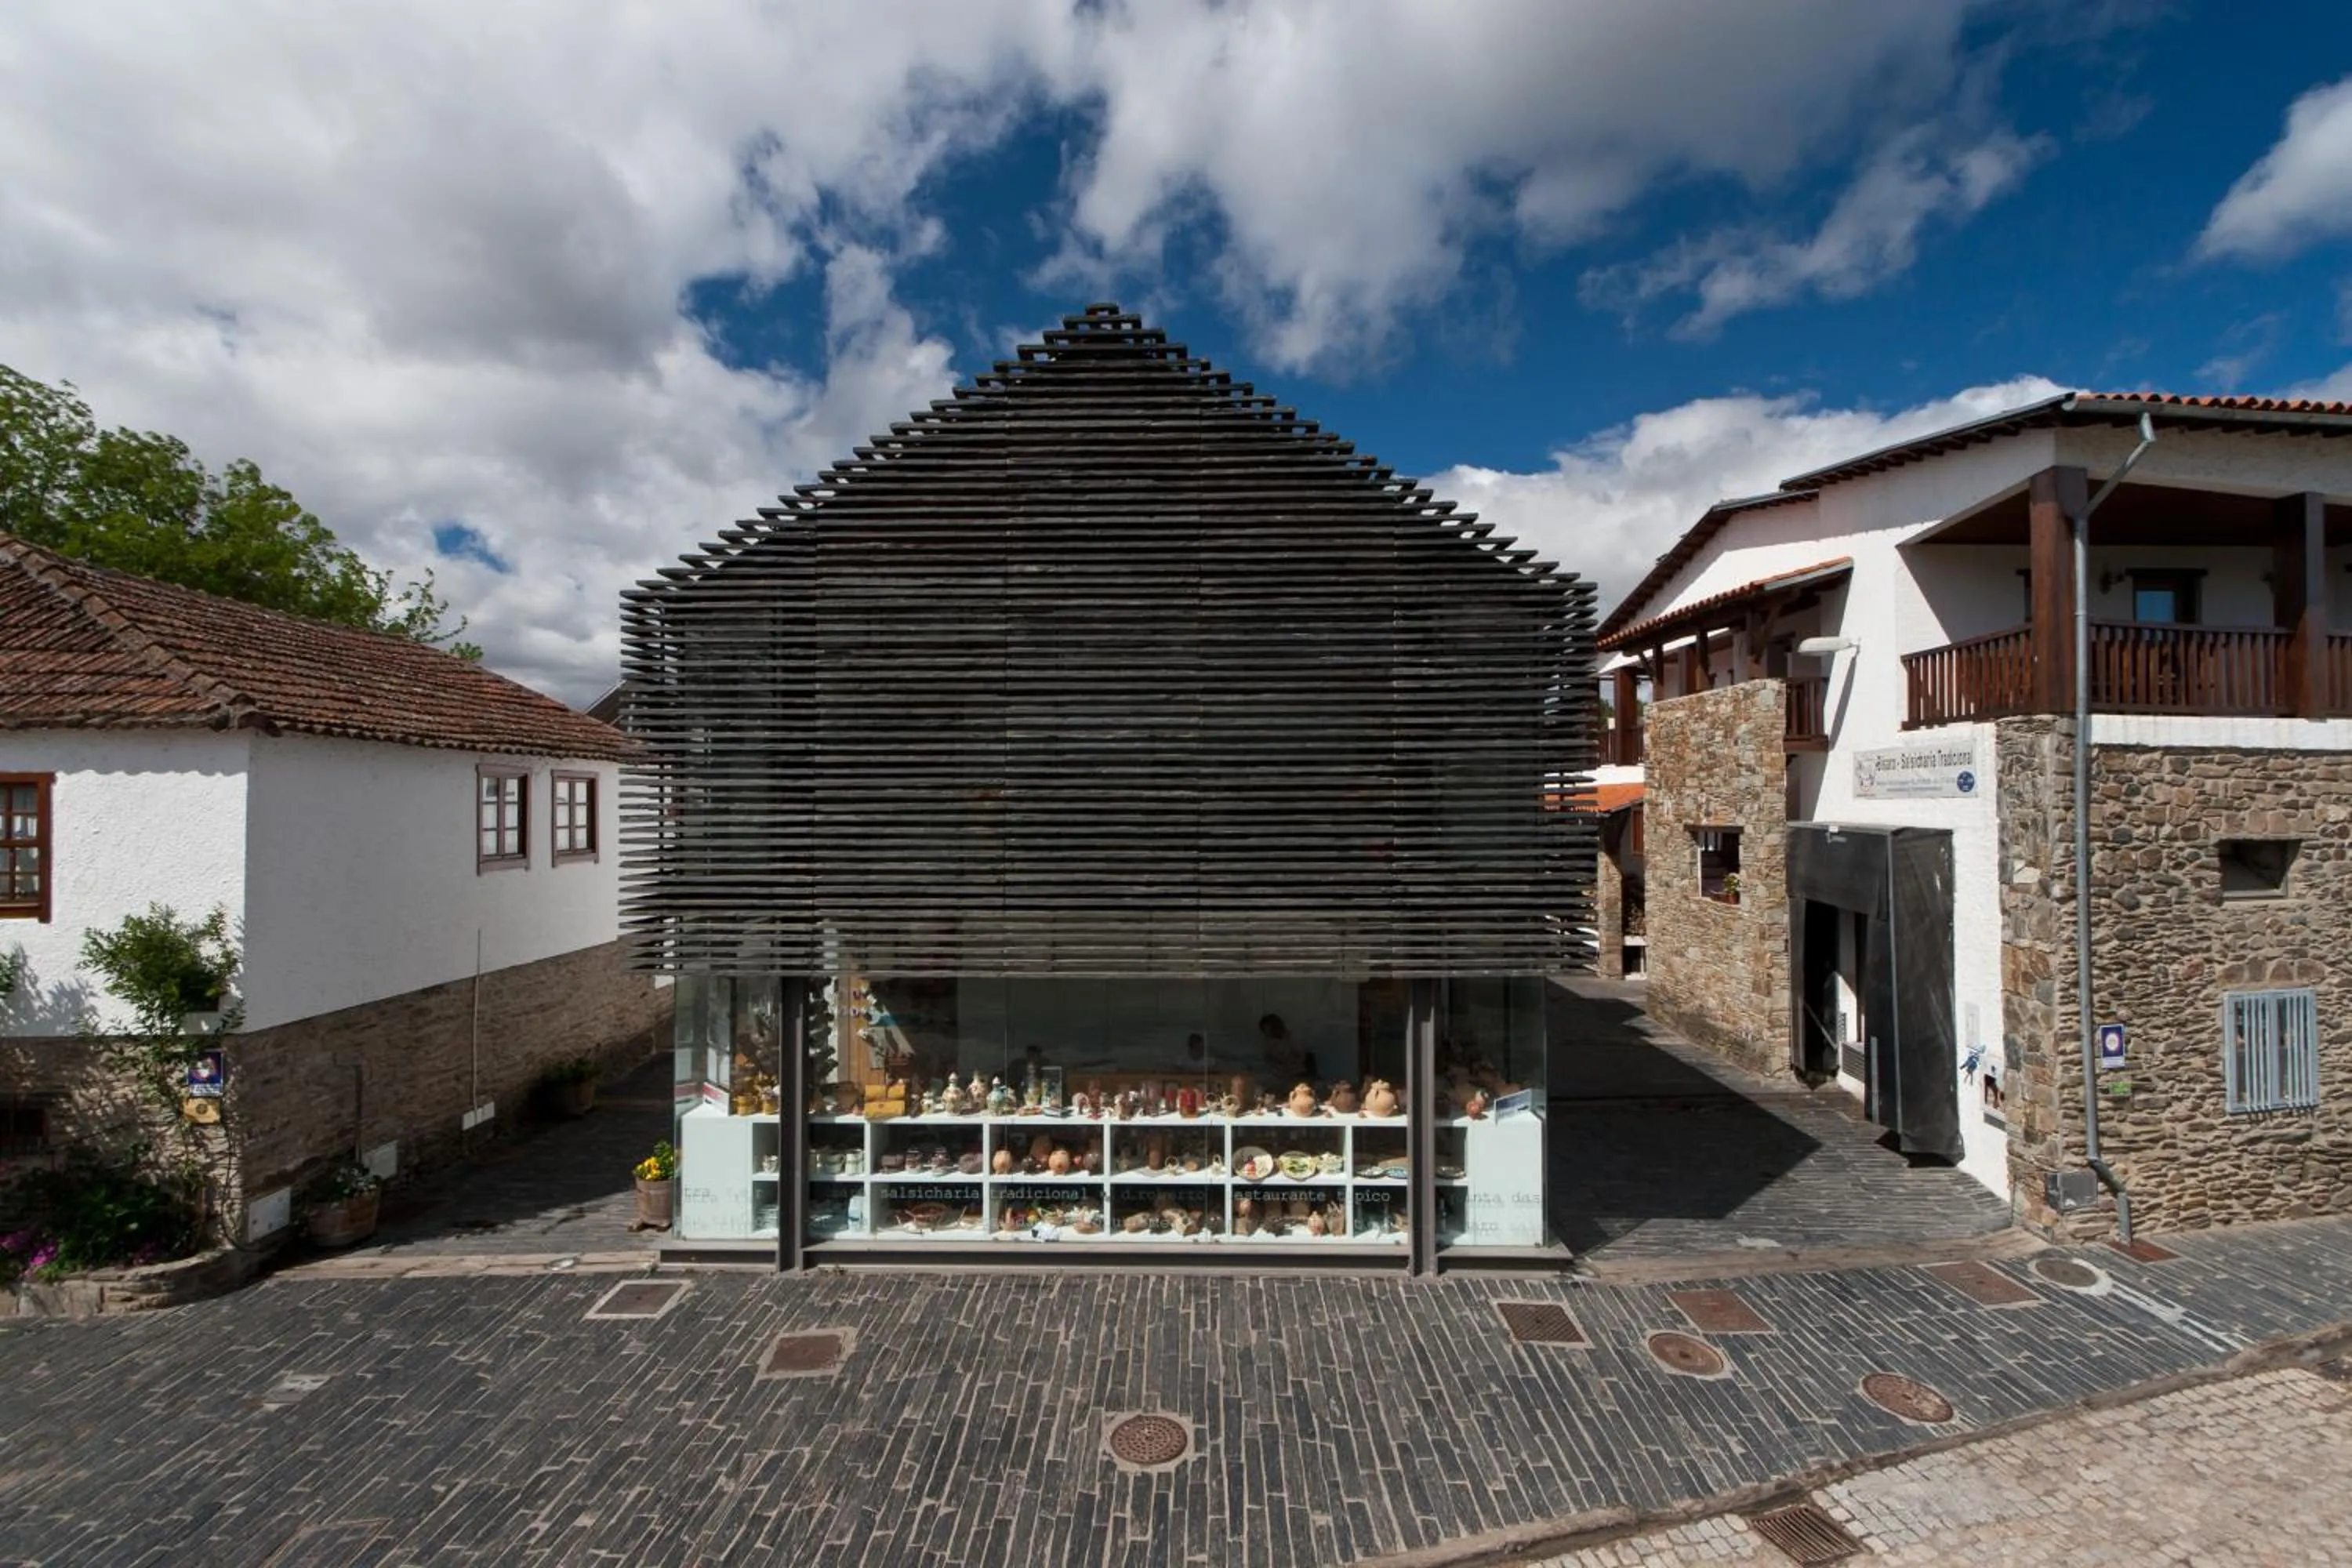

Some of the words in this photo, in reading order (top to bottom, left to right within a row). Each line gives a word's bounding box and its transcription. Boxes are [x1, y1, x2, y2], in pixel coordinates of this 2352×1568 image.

[880, 1185, 979, 1200] salsicharia
[989, 1186, 1089, 1200] tradicional
[1225, 1188, 1327, 1202] estaurante
[1336, 1189, 1391, 1205] tpico
